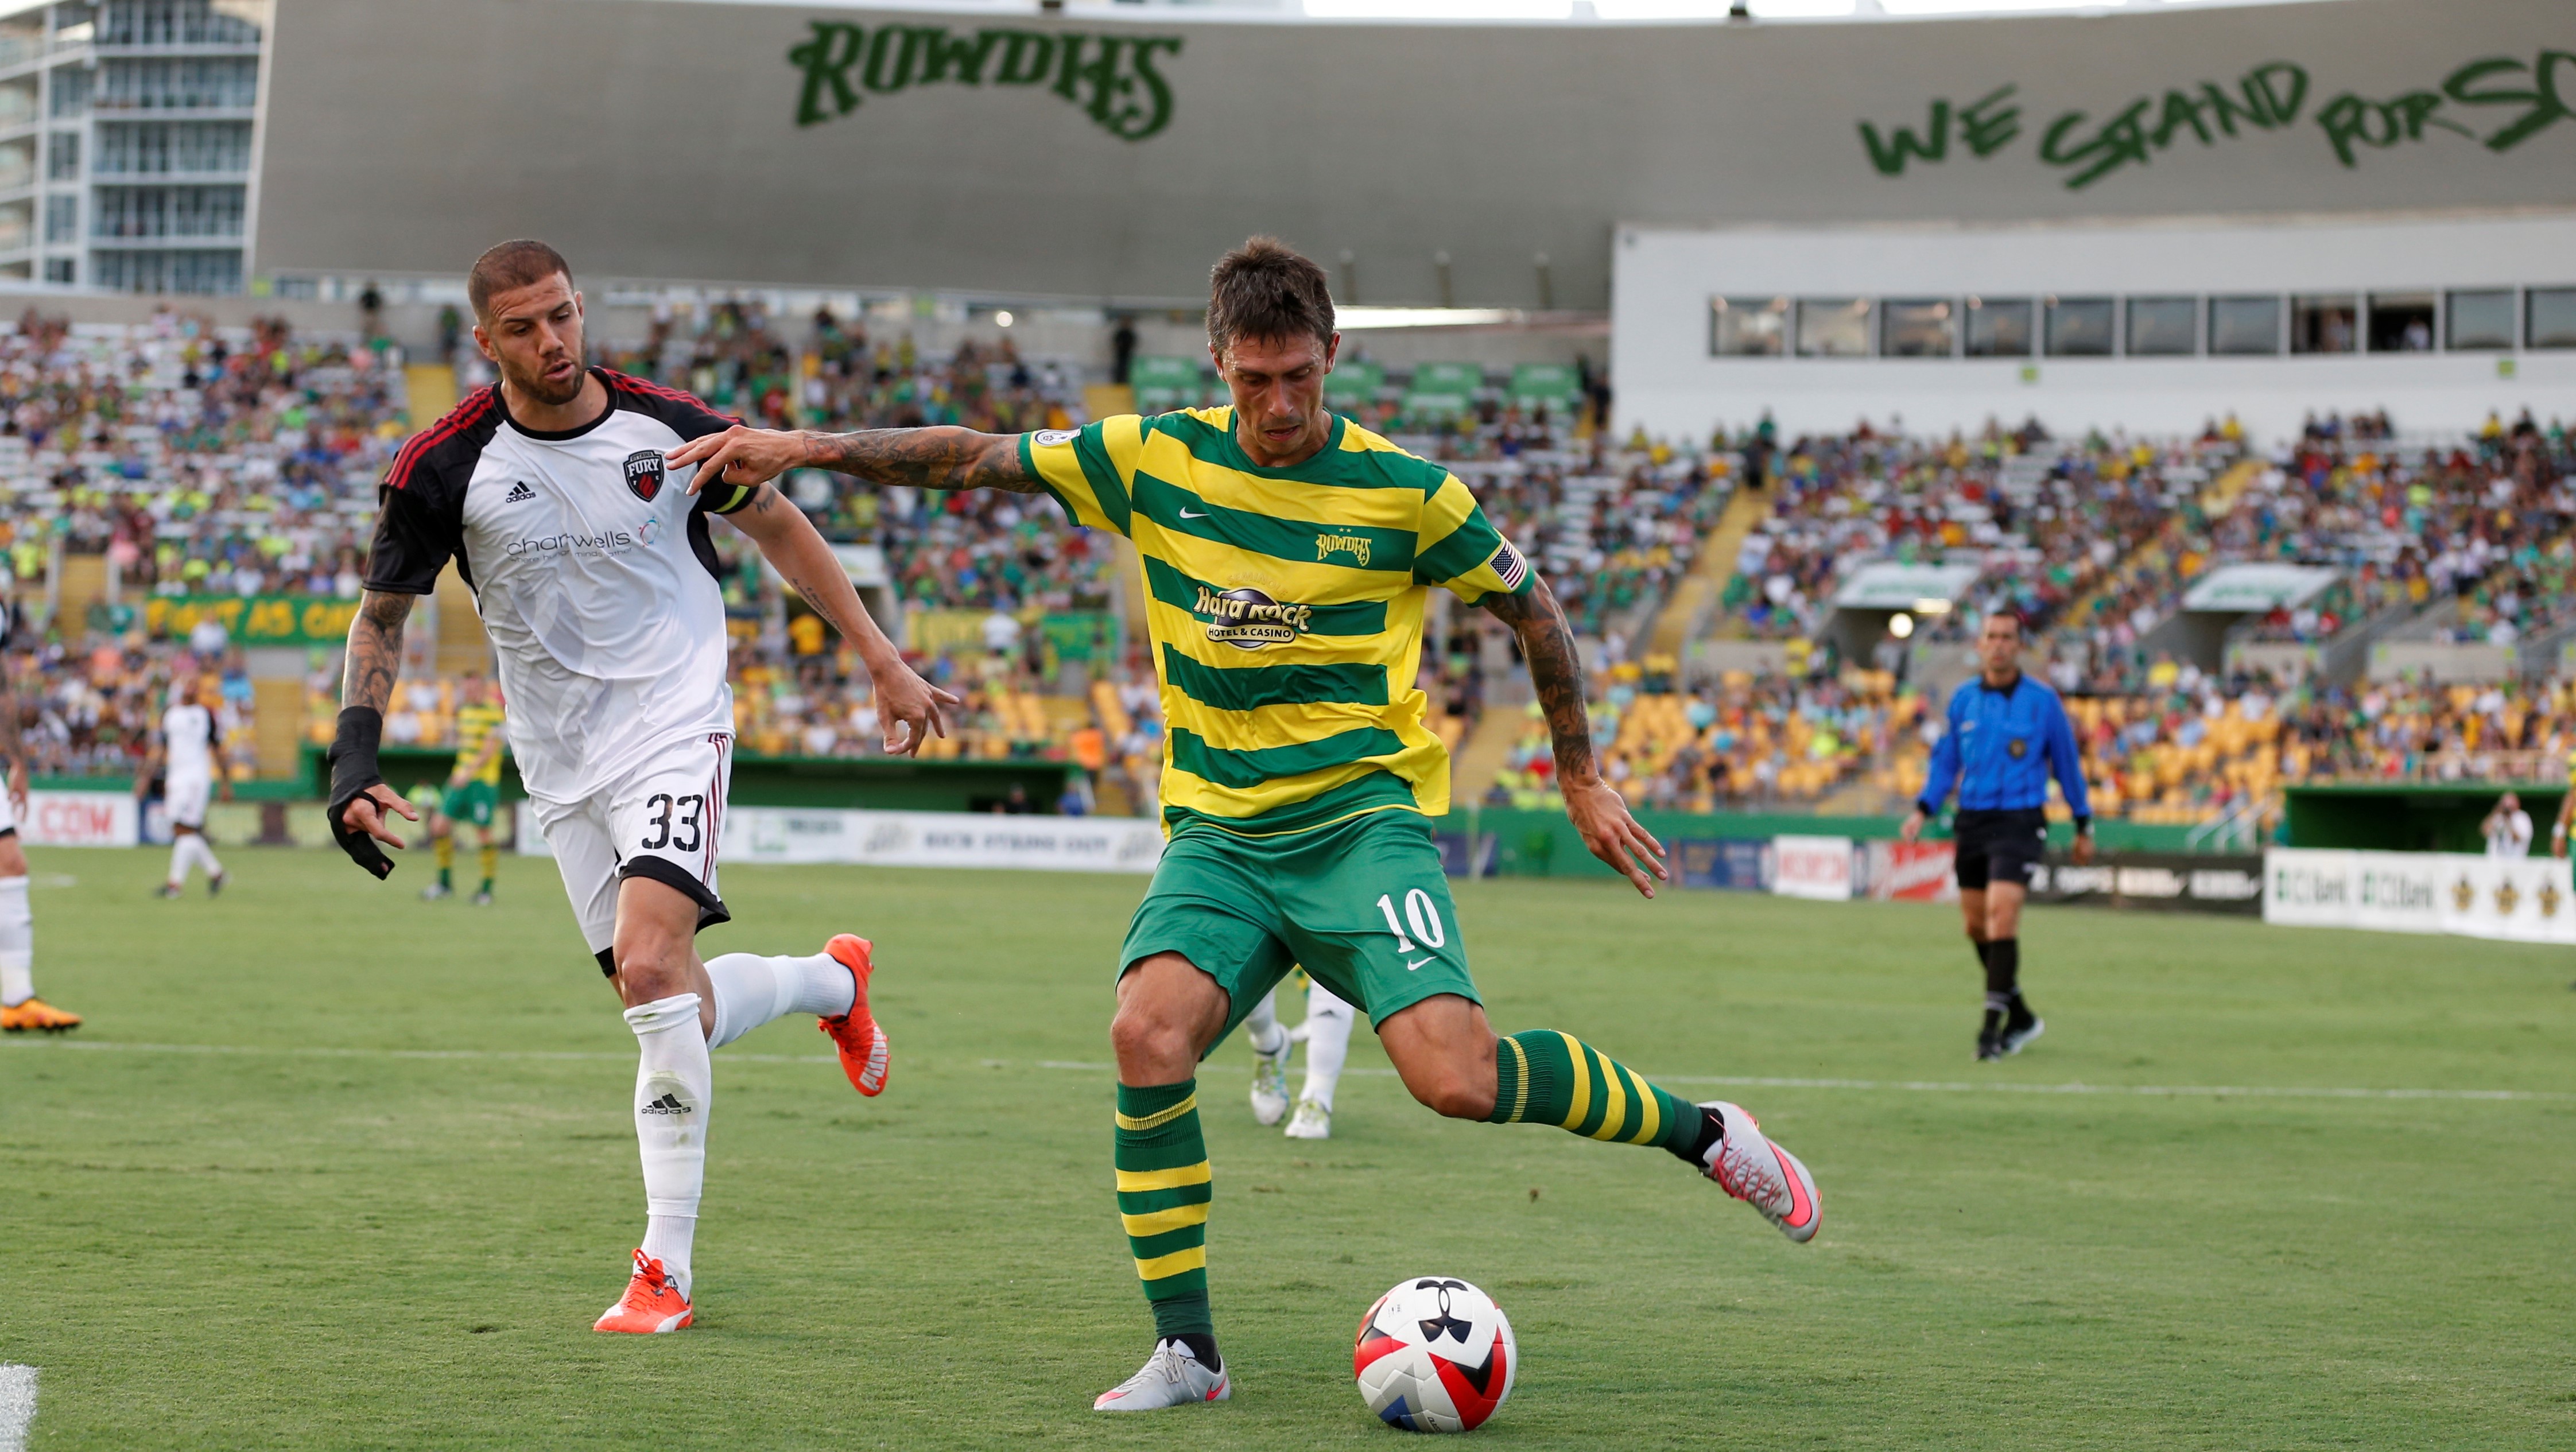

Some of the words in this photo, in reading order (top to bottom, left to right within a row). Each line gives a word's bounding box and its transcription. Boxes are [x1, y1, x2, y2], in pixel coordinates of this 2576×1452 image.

[1857, 84, 2023, 177] WE
[2039, 61, 2310, 191] STAND
[627, 458, 659, 477] FURY
[506, 491, 537, 503] adidas
[1209, 628, 1239, 637] HOTEL
[1240, 628, 1248, 636] &
[1250, 628, 1291, 638] CASINO
[641, 793, 704, 852] 33
[1376, 888, 1445, 953] 10
[641, 1106, 692, 1115] adidas
